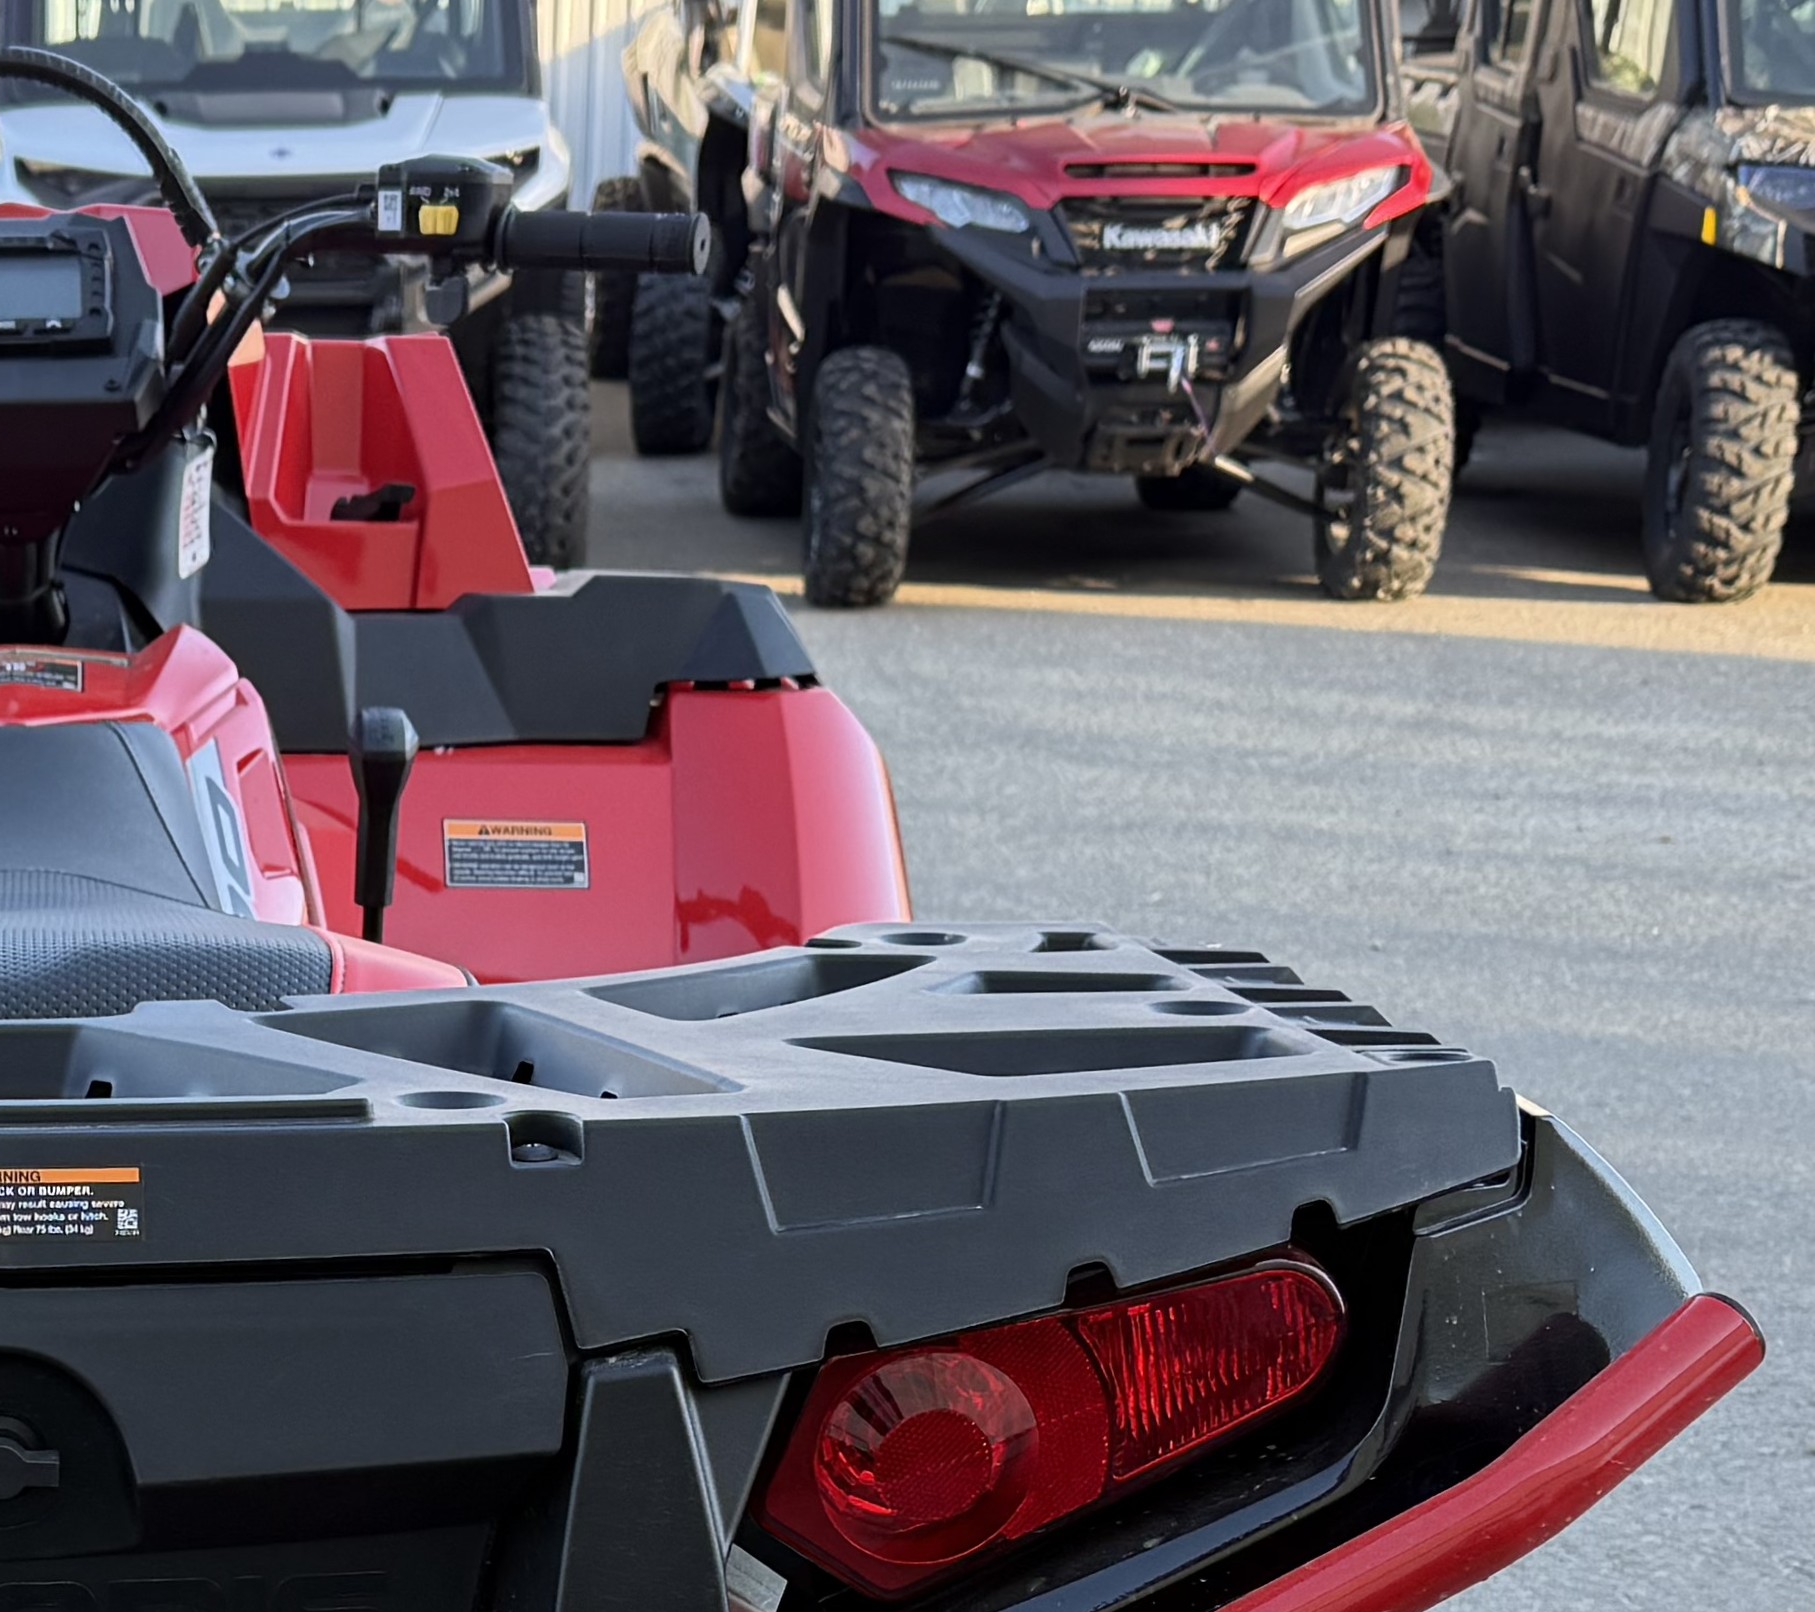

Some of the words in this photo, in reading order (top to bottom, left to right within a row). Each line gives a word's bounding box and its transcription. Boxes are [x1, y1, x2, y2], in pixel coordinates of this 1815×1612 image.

[491, 825, 553, 836] WARNING
[18, 1186, 35, 1196] OR
[39, 1186, 94, 1196] BUMPER.
[18, 1199, 47, 1209] result
[49, 1200, 89, 1210] causing
[13, 1213, 32, 1222] tow
[34, 1211, 65, 1221] hooks
[68, 1213, 79, 1221] or
